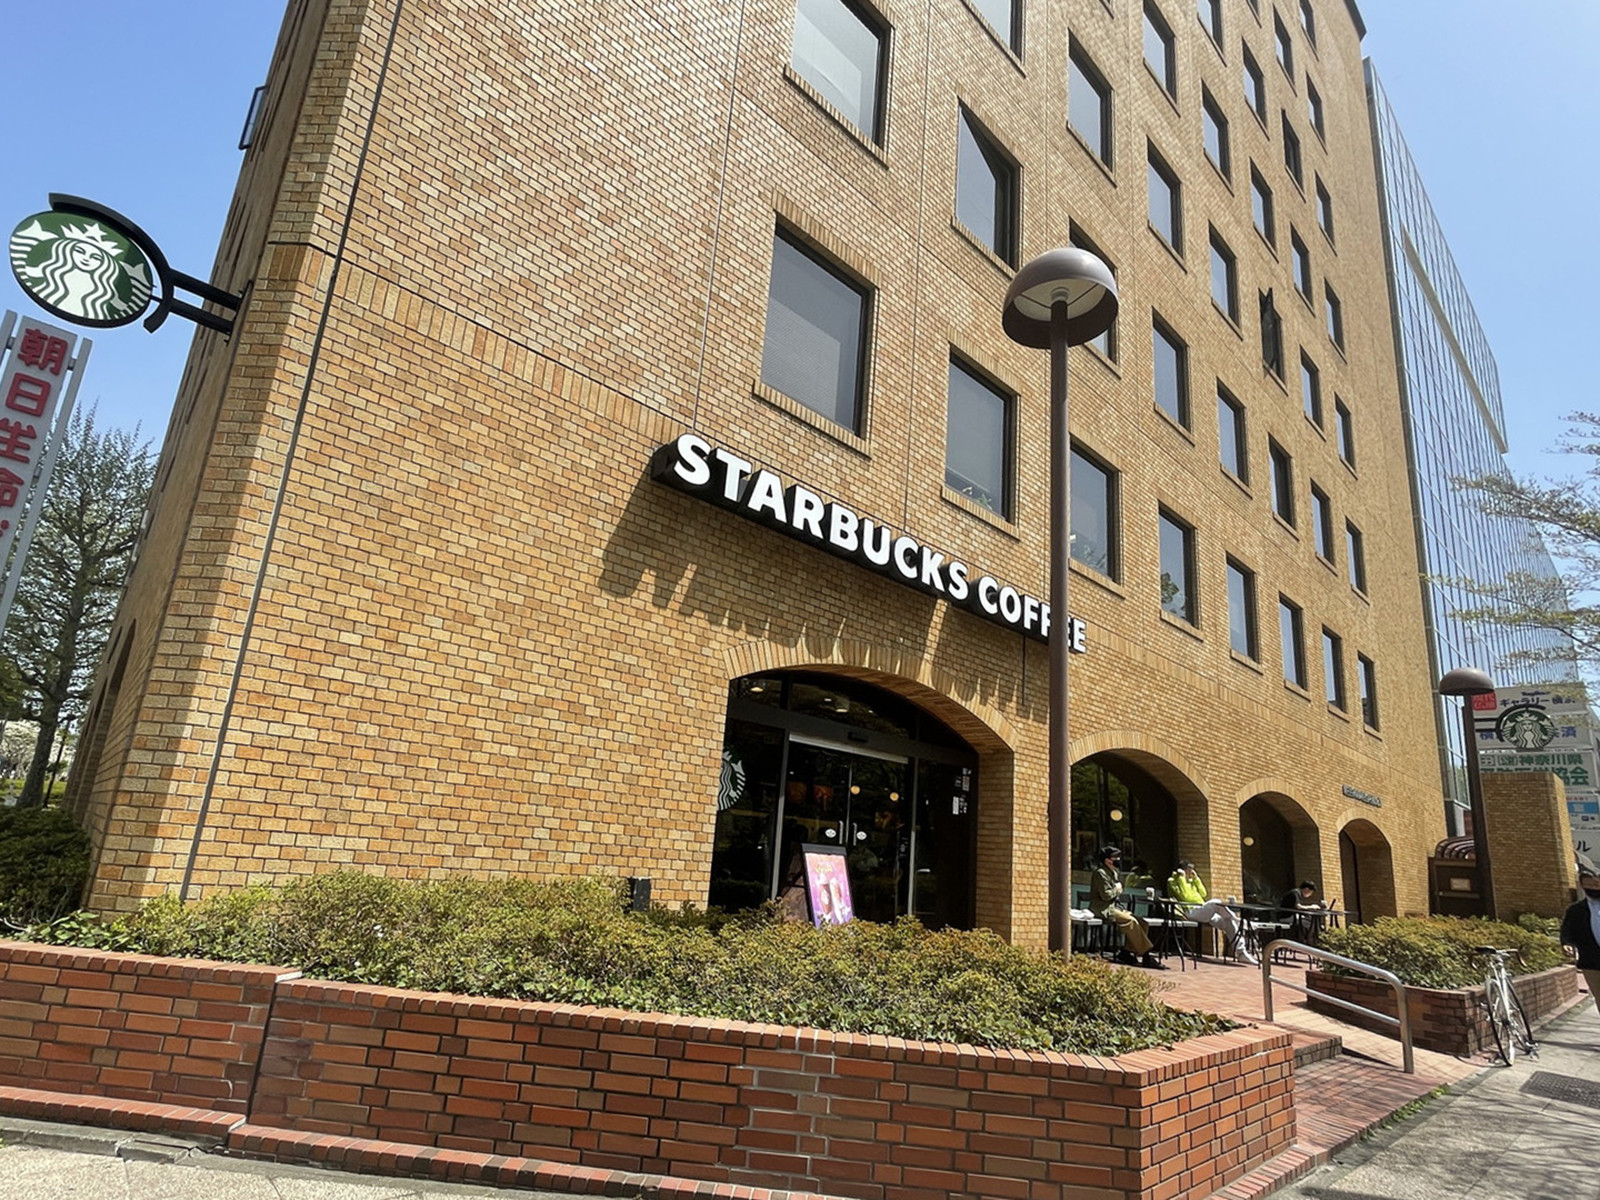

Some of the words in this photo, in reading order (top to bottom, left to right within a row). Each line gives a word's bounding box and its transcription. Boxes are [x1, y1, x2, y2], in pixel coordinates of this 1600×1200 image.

[0, 329, 68, 537] 朝日生命
[674, 434, 969, 600] STARBUCKS
[978, 576, 1086, 653] COFFE
